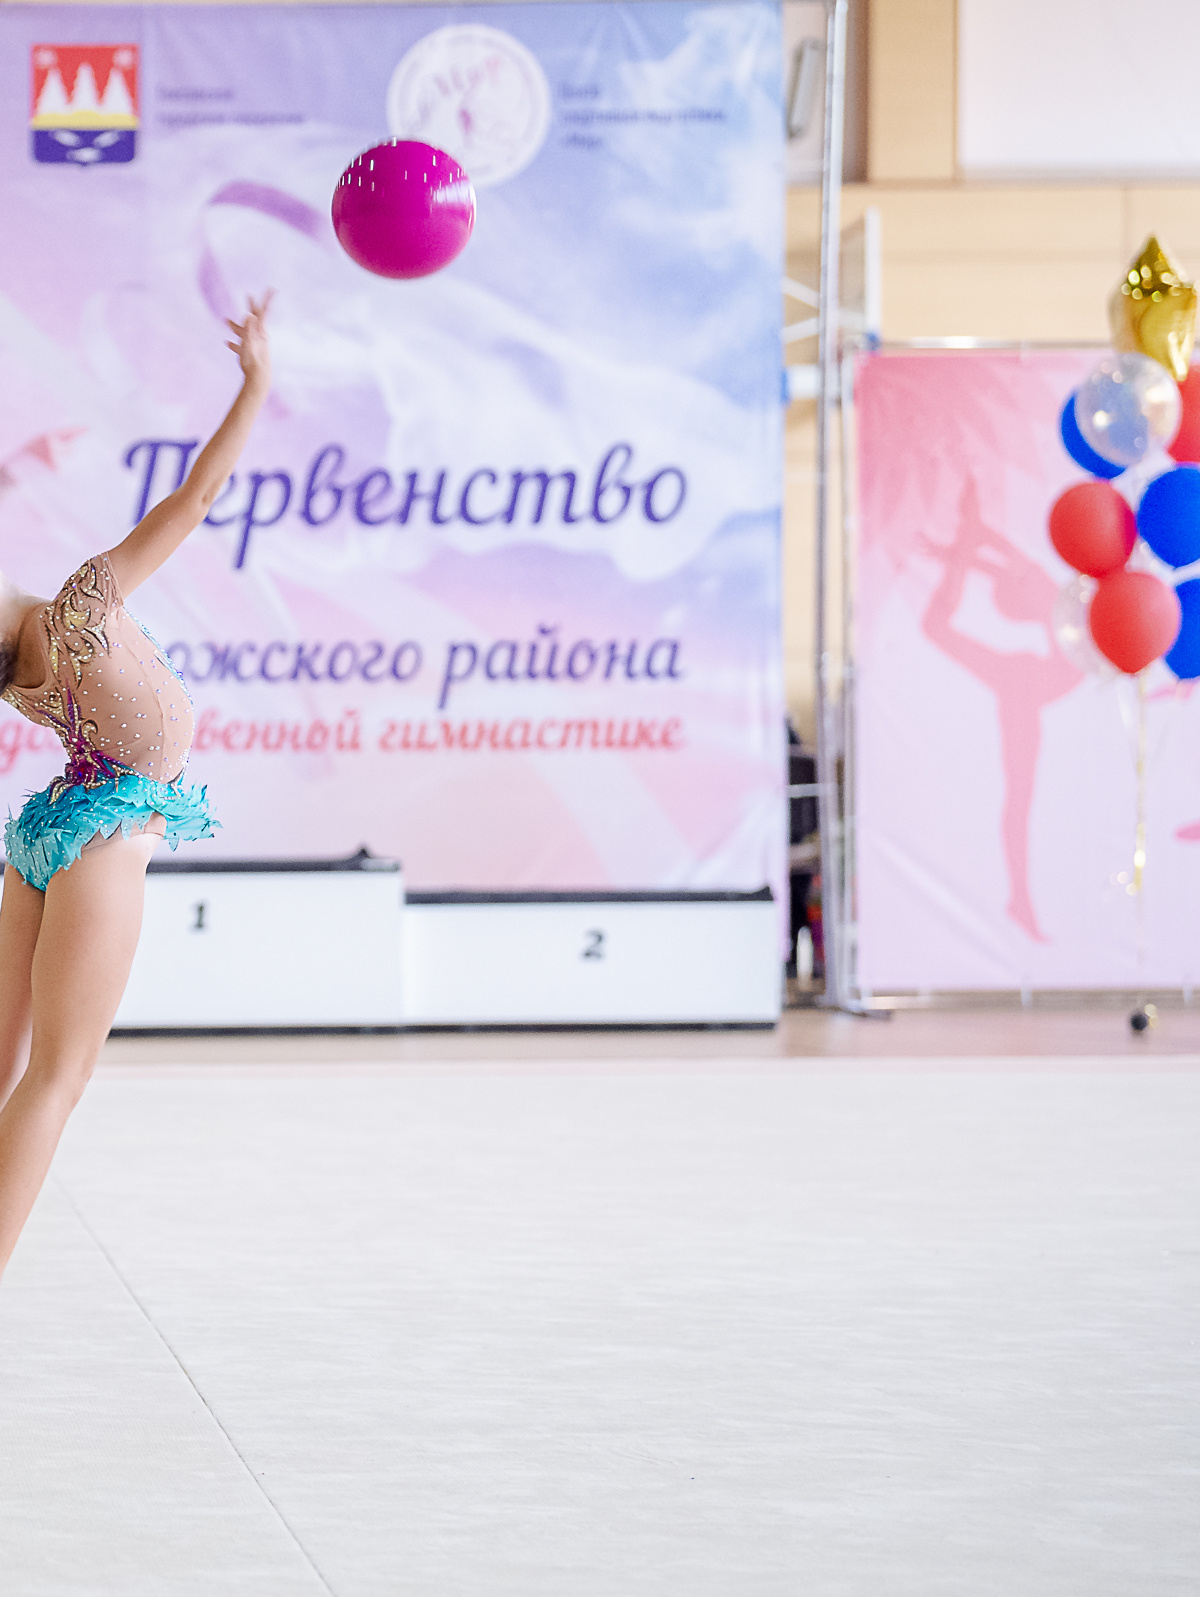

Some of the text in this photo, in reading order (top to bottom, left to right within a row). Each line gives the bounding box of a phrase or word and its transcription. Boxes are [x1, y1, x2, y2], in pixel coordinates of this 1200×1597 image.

[166, 622, 684, 711] ожского района
[379, 714, 685, 753] гимнастике
[189, 900, 210, 933] 1
[581, 927, 606, 961] 2
